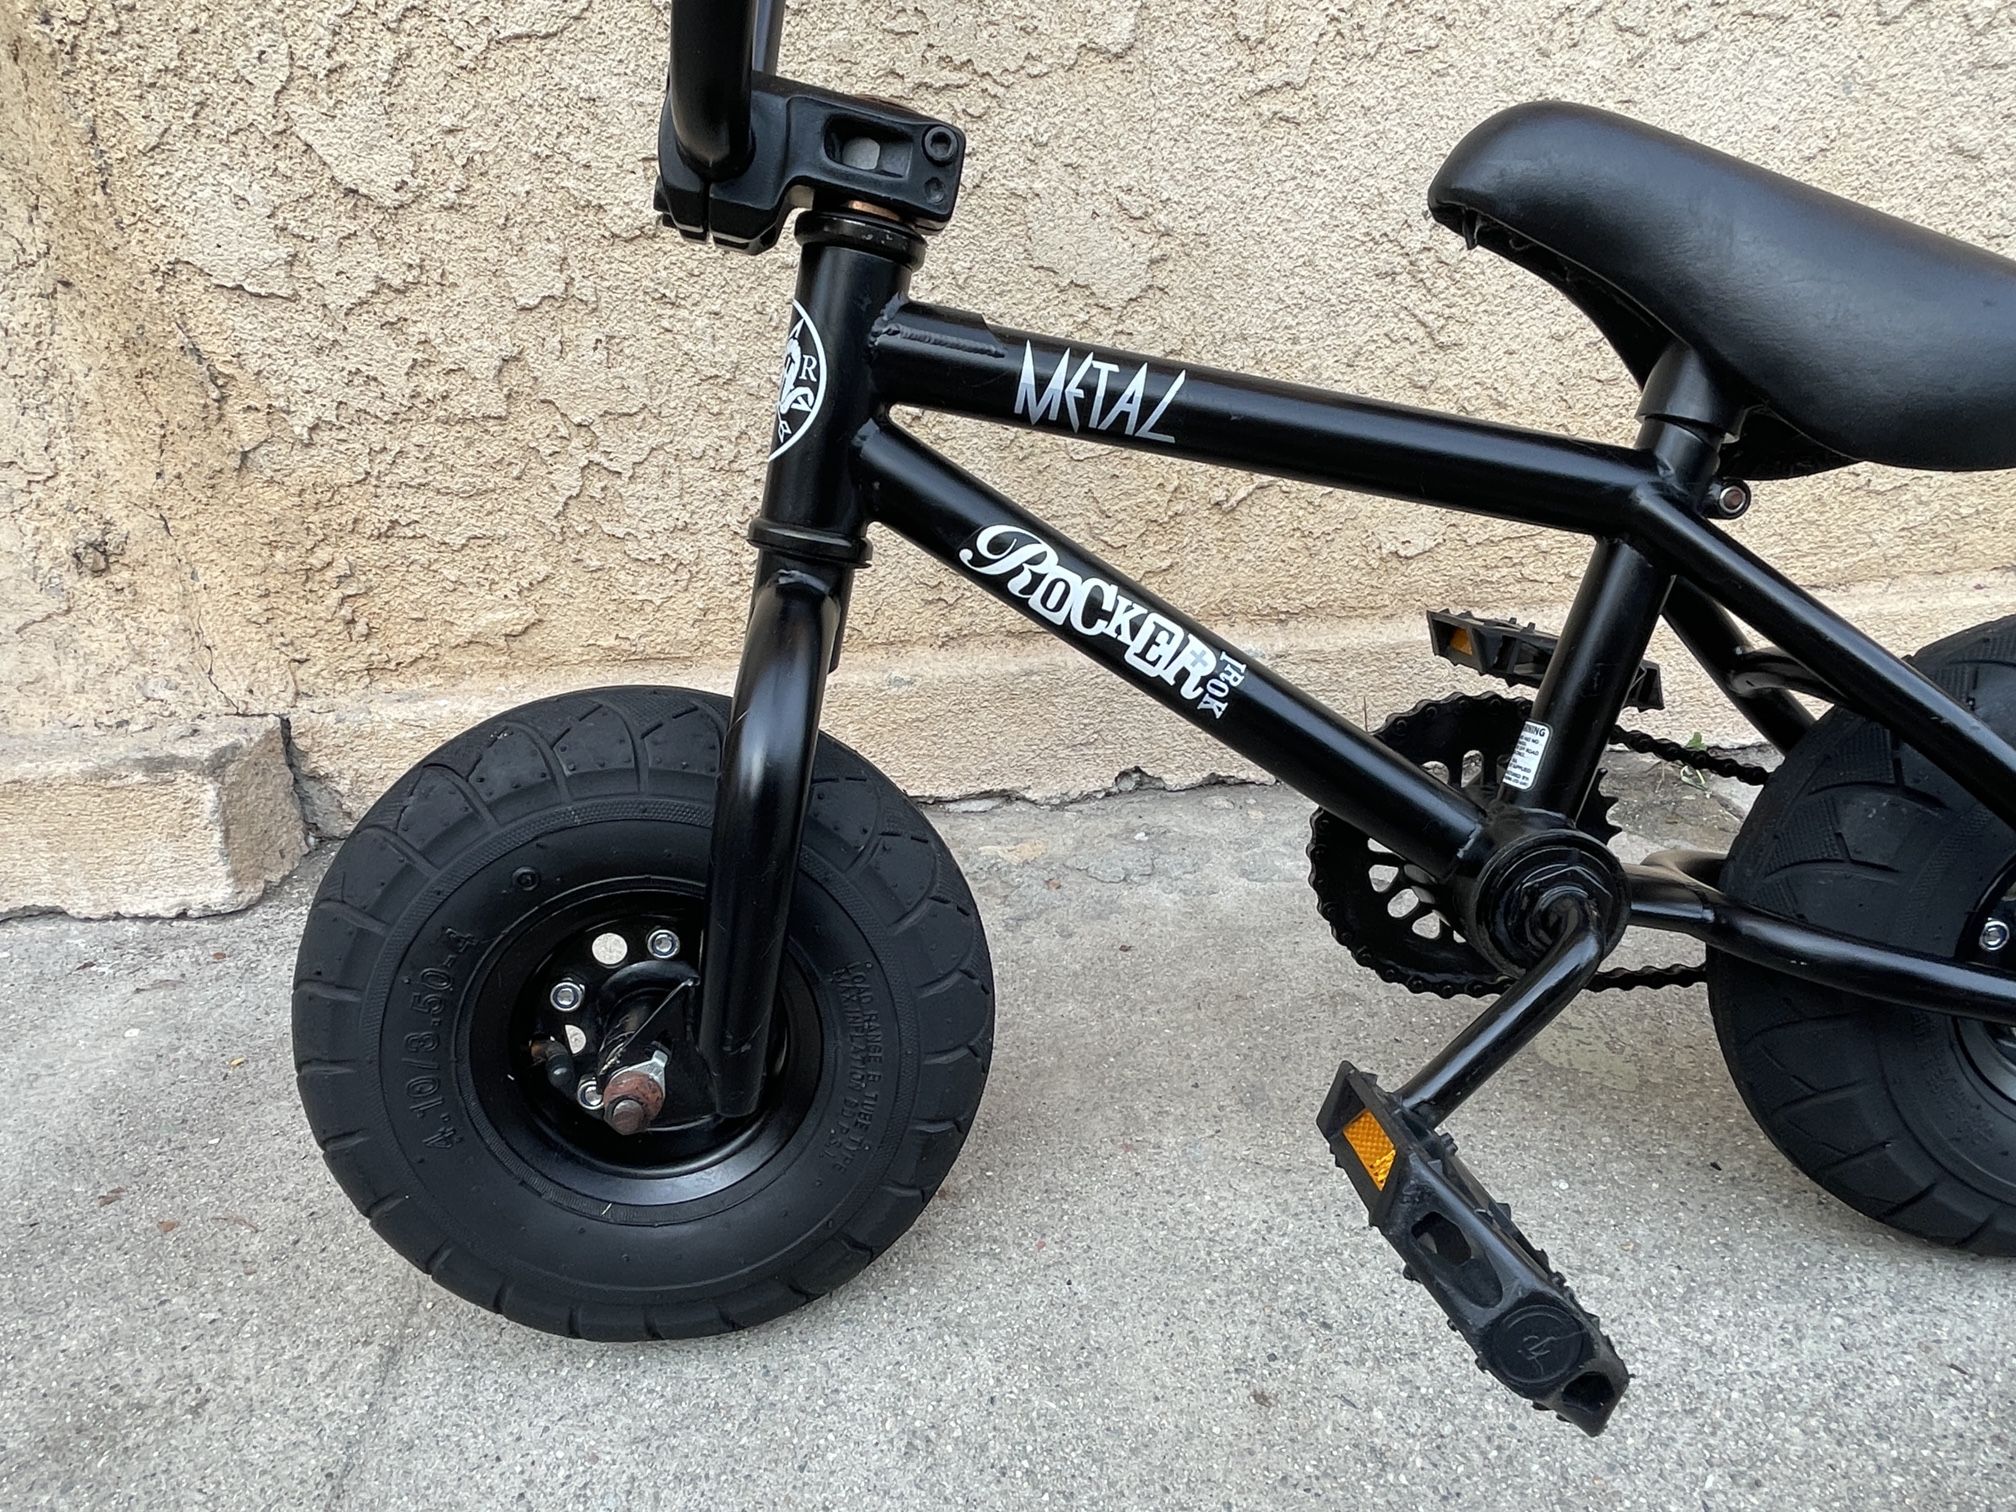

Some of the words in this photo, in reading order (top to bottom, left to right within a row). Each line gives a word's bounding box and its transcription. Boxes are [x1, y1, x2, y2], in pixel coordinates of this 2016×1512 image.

[1014, 339, 1186, 444] METAL
[959, 524, 1217, 700] ROCKER
[1197, 651, 1248, 719] IROK
